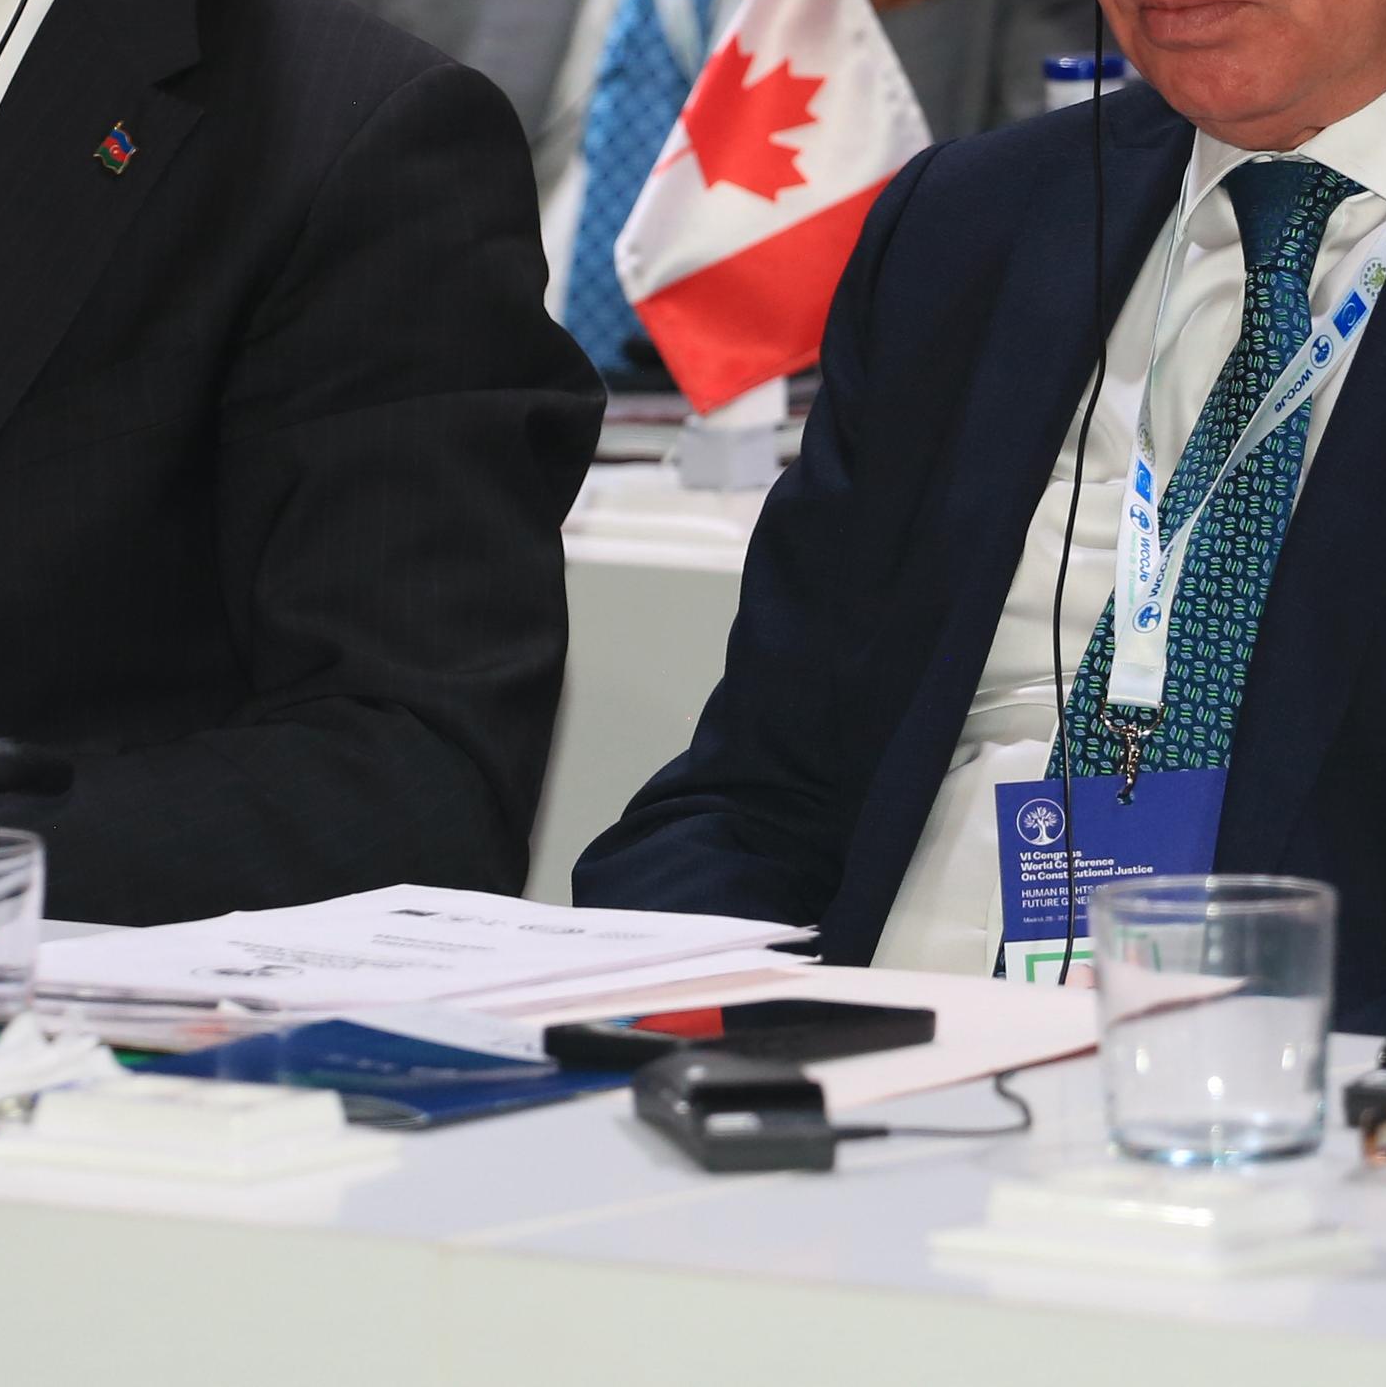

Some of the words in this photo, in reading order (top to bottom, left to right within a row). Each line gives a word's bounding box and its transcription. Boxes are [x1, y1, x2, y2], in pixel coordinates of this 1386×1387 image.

[1020, 852, 1031, 861] VI
[1033, 850, 1082, 861] Congrss
[1021, 861, 1053, 871] World
[1021, 873, 1036, 881] On
[1115, 865, 1154, 875] Justice
[1022, 887, 1058, 898] HUMAN
[1059, 885, 1094, 896] RIHTS
[1022, 897, 1059, 908] FUTURE
